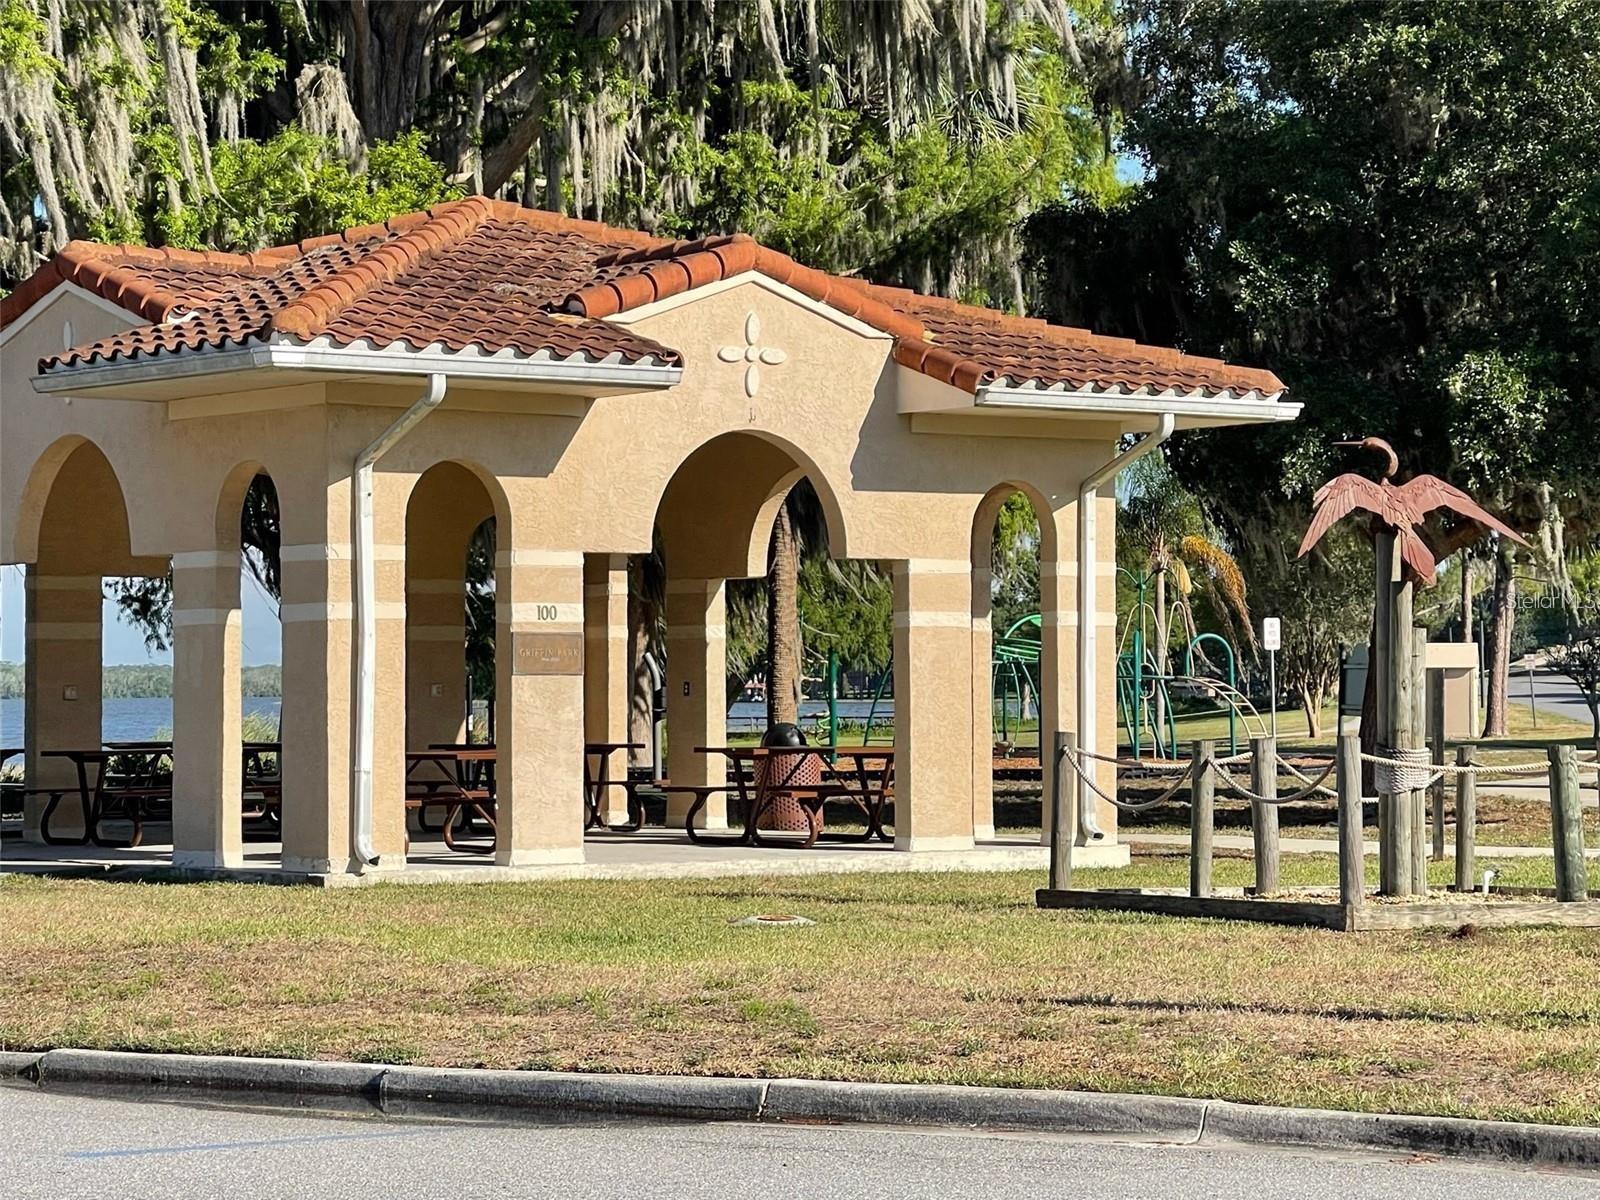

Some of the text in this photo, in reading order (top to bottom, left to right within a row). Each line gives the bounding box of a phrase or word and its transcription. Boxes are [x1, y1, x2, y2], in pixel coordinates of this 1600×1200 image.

[537, 605, 557, 620] 100
[519, 647, 579, 658] GRIFFIN PARK
